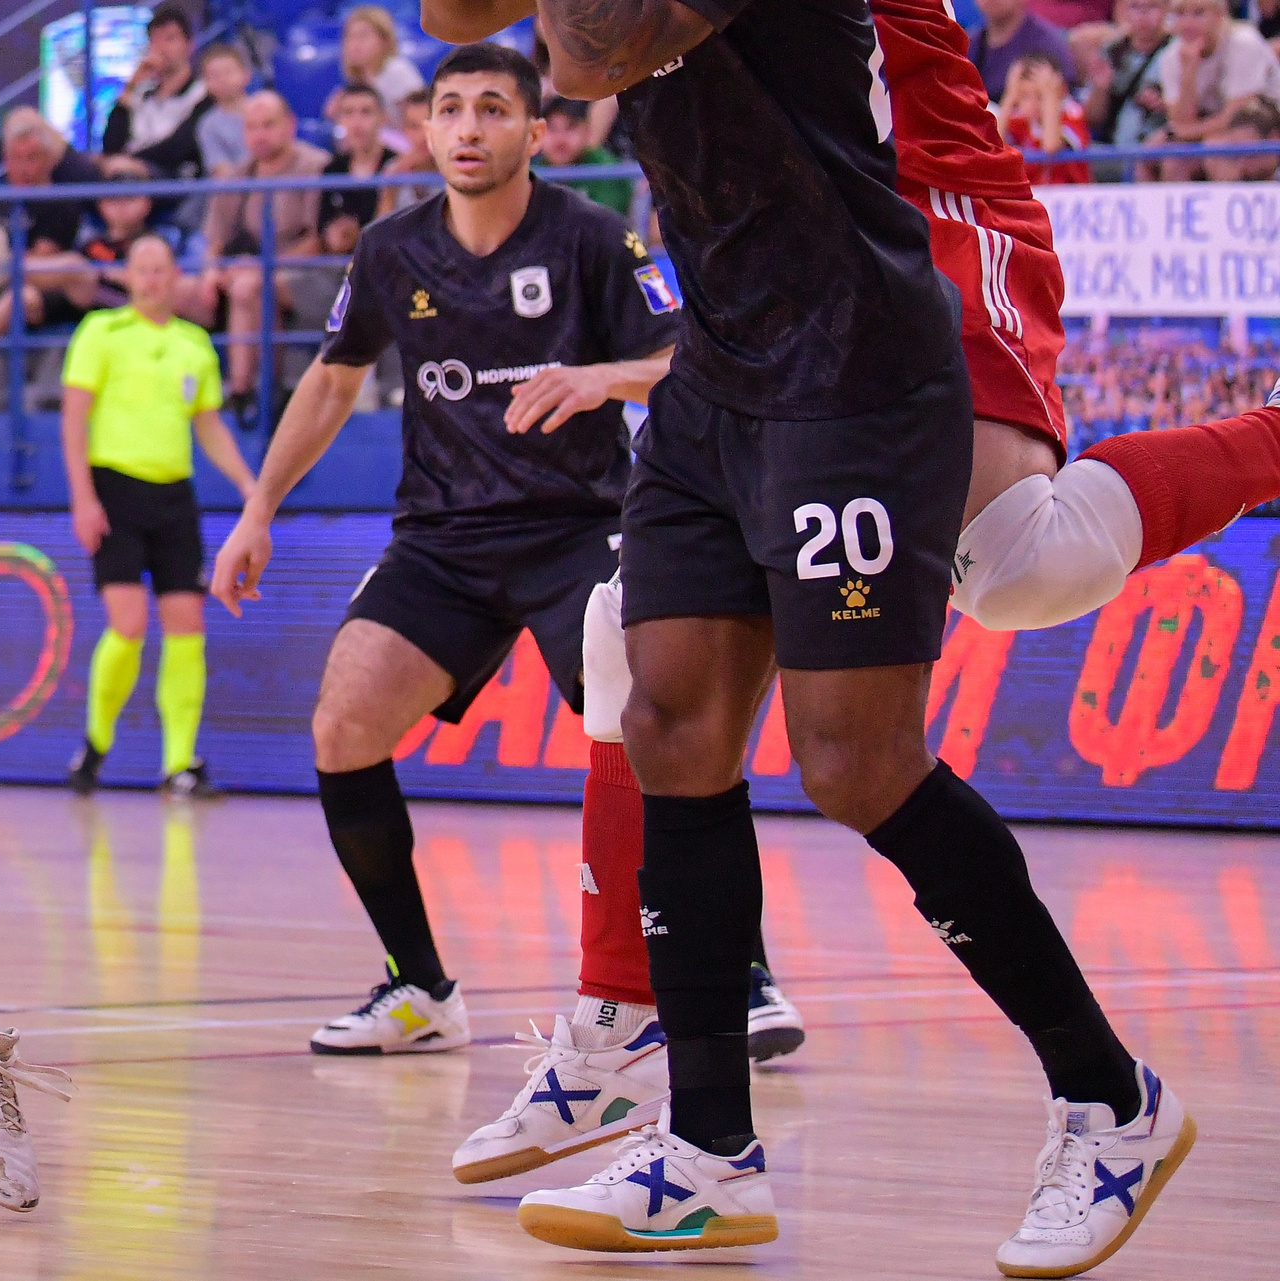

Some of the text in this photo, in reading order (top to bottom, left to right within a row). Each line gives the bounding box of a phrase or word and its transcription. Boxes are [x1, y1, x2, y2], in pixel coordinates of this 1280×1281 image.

[1164, 192, 1211, 242] НЕ
[1152, 252, 1211, 301] МЫ
[793, 497, 894, 580] 20
[831, 607, 881, 621] KELME
